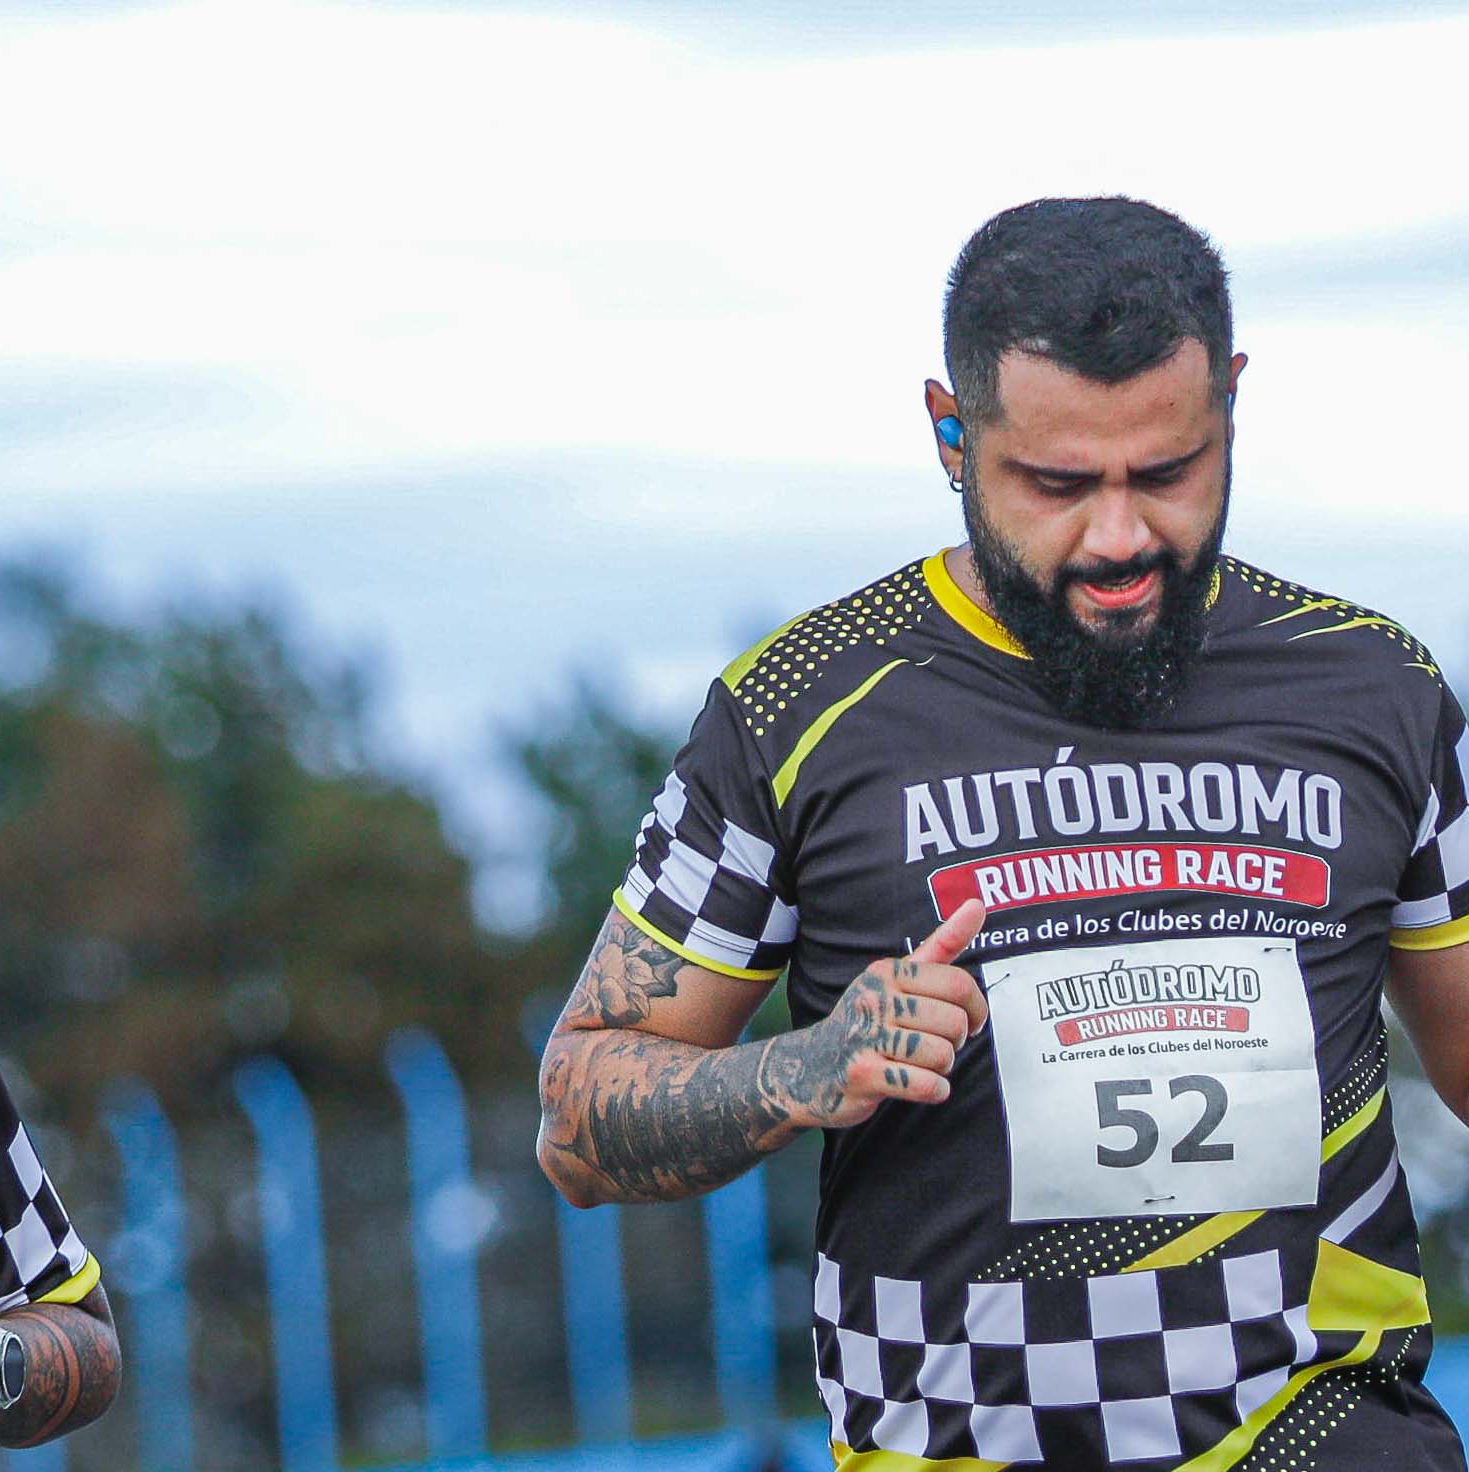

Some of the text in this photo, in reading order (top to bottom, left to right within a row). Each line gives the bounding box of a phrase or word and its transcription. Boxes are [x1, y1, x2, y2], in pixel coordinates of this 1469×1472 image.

[904, 746, 1342, 864] AUTÓDROMO
[974, 849, 1286, 909] RUNNING RACE
[965, 927, 1030, 950] rrera
[1037, 918, 1069, 940] de
[1076, 914, 1110, 935] los
[1118, 909, 1202, 932] Clubes
[1210, 908, 1249, 931] del
[1035, 958, 1261, 1021] AUTÓDROMO
[1042, 1037, 1269, 1064] La Carrera de los Clubes del Noroeste
[1076, 1007, 1227, 1040] RUNNING RACE
[1093, 1074, 1234, 1170] 52
